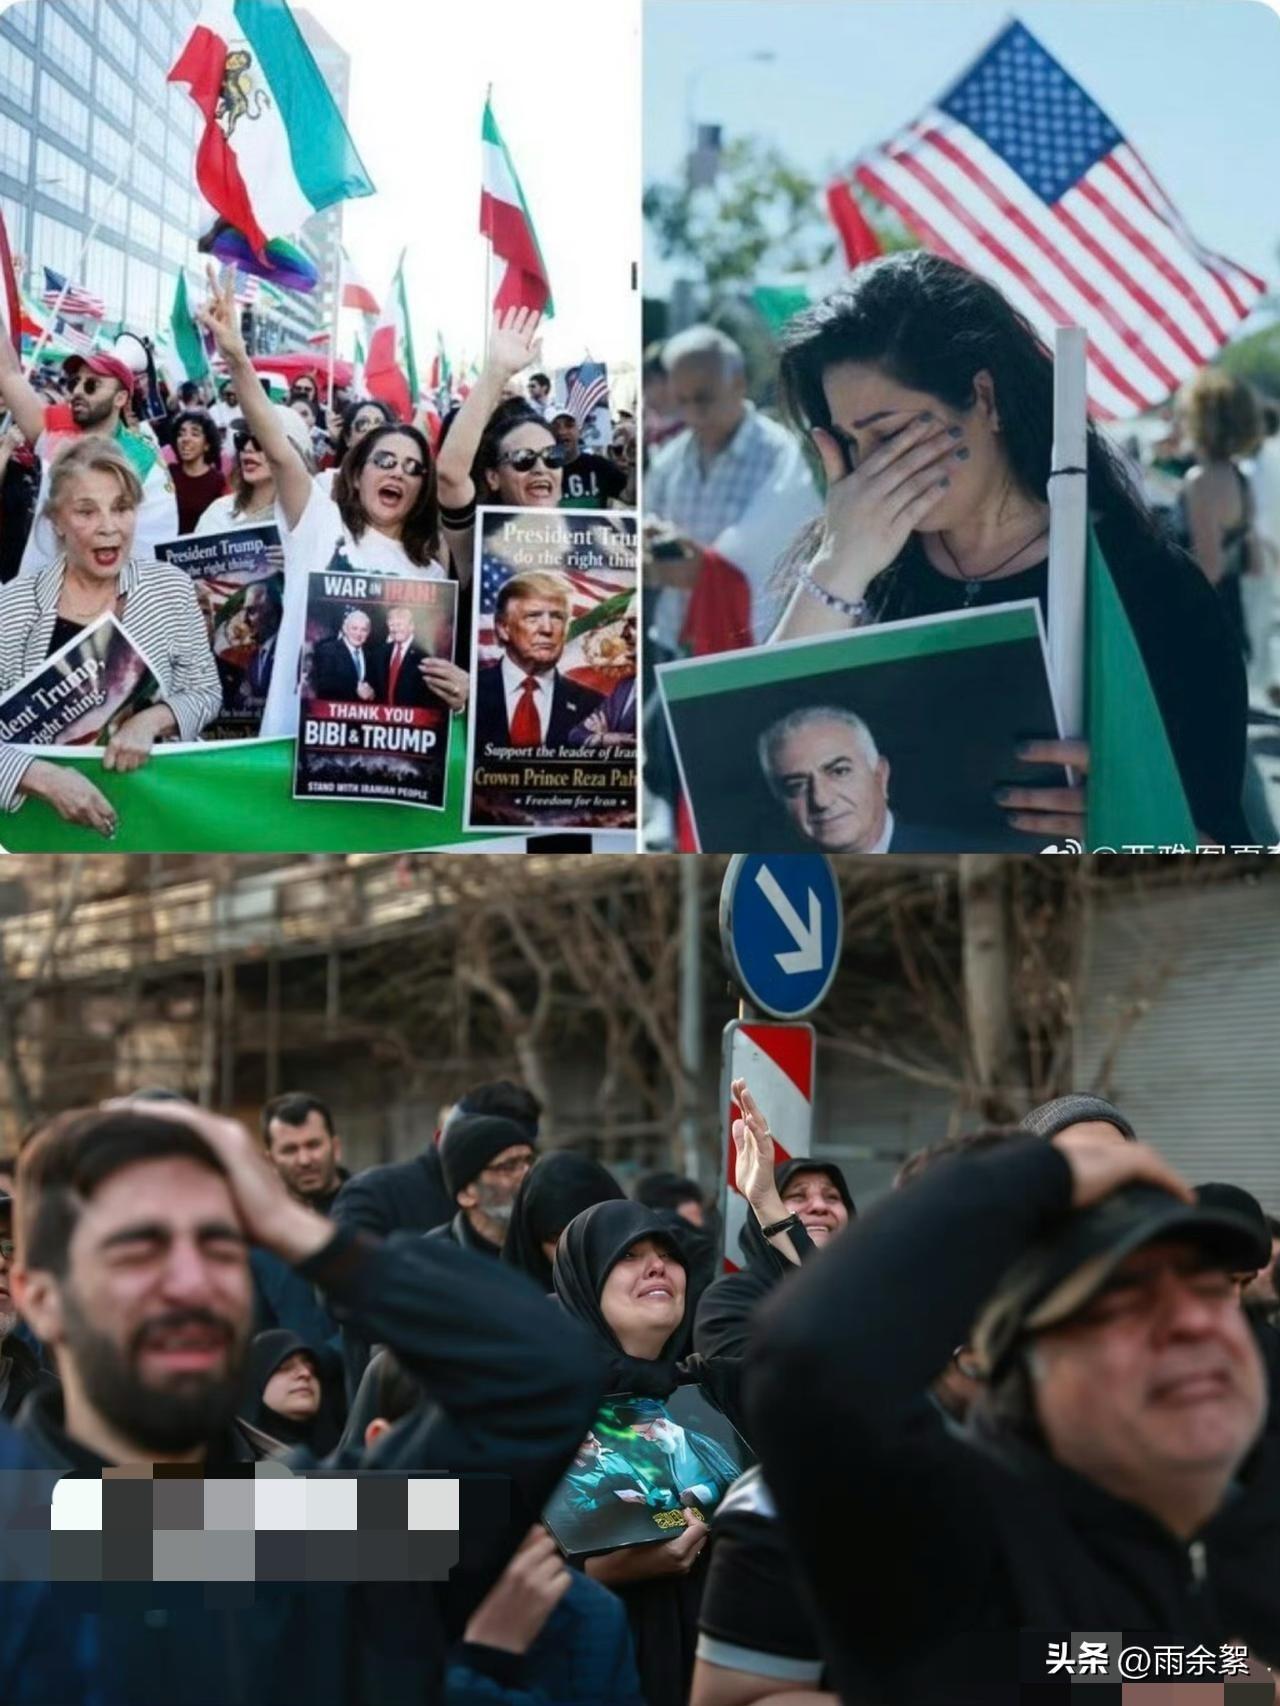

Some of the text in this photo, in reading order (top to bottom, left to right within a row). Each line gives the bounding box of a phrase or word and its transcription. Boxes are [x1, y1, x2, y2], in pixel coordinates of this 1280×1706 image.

[504, 522, 593, 546] President
[166, 544, 217, 563] President
[513, 549, 533, 564] do
[538, 550, 562, 564] the
[567, 551, 603, 569] right
[324, 576, 366, 597] WAR
[32, 659, 105, 710] Trump,
[328, 704, 414, 724] THANK YOU
[305, 720, 437, 754] BIBI & TRUMP
[484, 742, 532, 760] Support
[536, 745, 555, 758] the
[559, 745, 594, 758] leader
[598, 746, 613, 761] of
[475, 767, 520, 786] Crown
[523, 768, 569, 786] Prince
[572, 769, 606, 786] Reza
[308, 781, 335, 792] STAND
[336, 782, 358, 793] WITH
[397, 786, 429, 801] PEOPLE
[526, 795, 616, 808] Freedom for Iran
